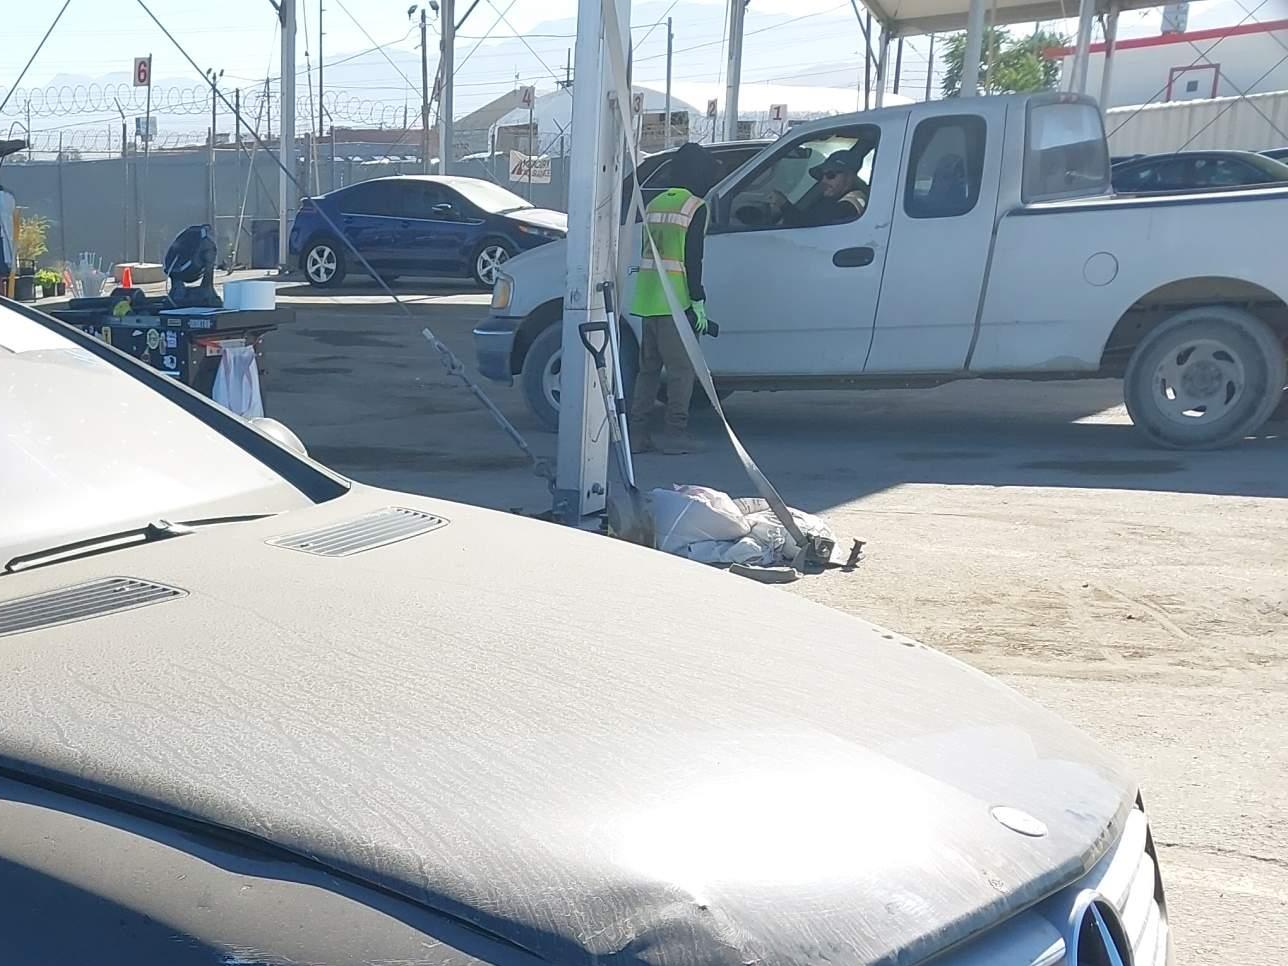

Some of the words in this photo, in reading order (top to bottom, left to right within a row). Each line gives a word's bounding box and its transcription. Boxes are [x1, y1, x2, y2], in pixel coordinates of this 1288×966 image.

[137, 60, 147, 84] 6
[522, 89, 532, 107] 4
[634, 96, 641, 113] 3
[709, 102, 715, 117] 2
[772, 105, 782, 121] 1
